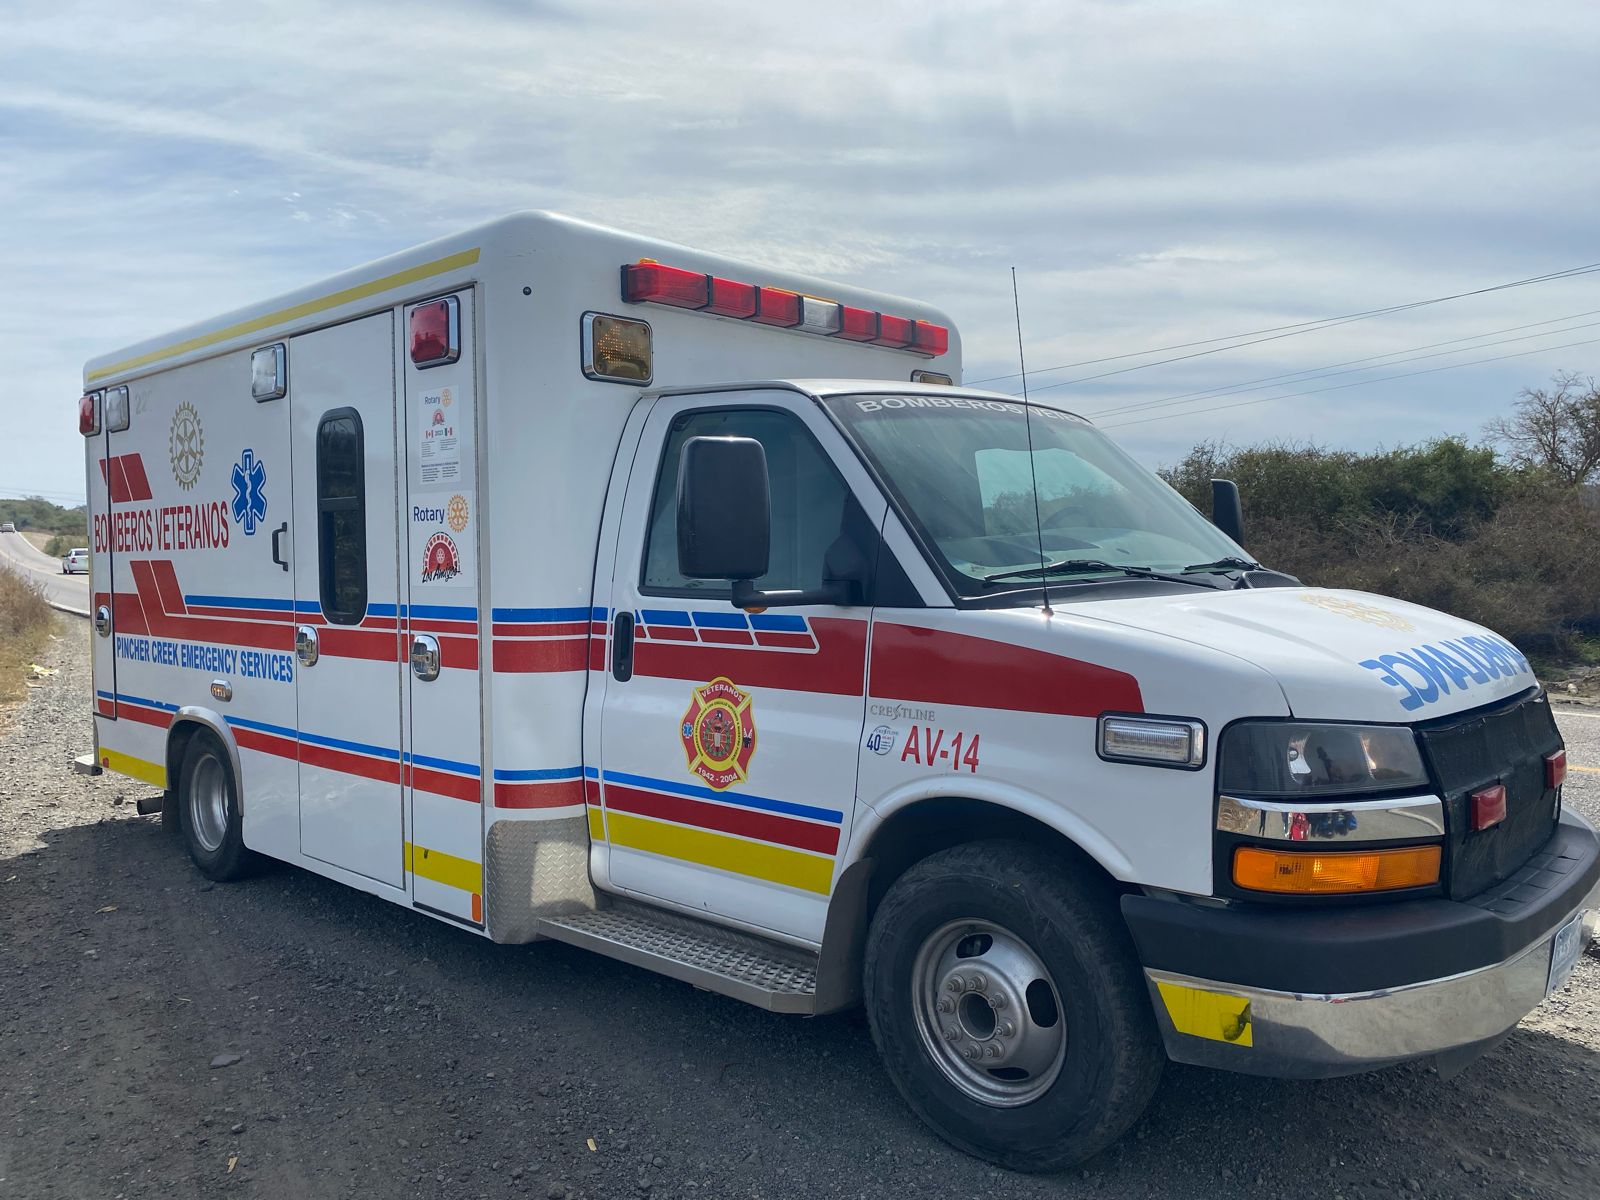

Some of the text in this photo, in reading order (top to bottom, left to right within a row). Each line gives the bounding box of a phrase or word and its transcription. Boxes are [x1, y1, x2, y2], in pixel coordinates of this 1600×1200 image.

[855, 398, 1024, 415] BOMBEROS
[413, 506, 445, 524] Rotary
[94, 501, 229, 553] BOMBEROS VETERANOS
[116, 636, 293, 683] PINCHER CREEK EMERGENCY SERVICES
[701, 684, 743, 702] VETERANOS
[870, 704, 936, 721] CRESTLINE
[866, 733, 881, 751] 40
[900, 725, 980, 774] AV-14
[697, 767, 715, 781] 1942
[720, 773, 738, 783] 2004
